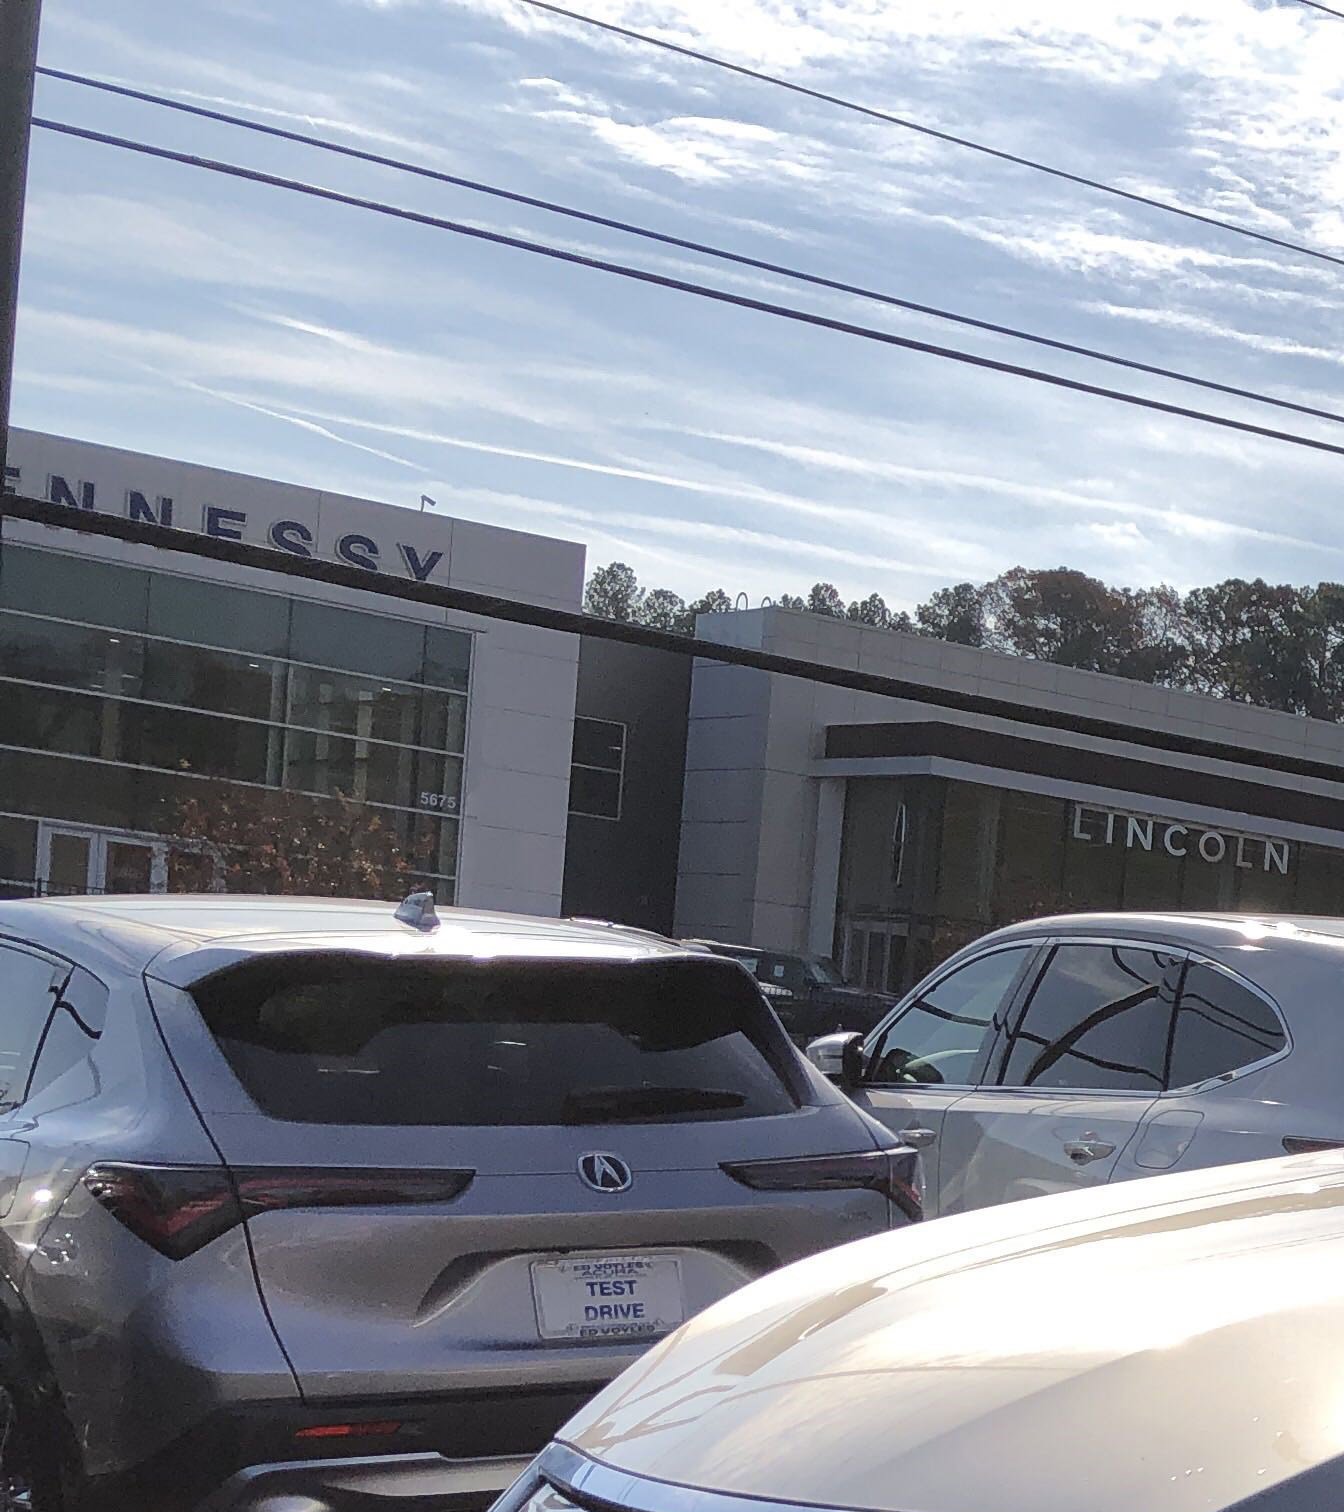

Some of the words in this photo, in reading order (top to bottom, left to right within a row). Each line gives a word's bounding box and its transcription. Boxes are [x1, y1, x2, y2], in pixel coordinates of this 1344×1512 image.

[420, 791, 457, 809] 5675
[1073, 803, 1290, 875] LINCOLN
[585, 1279, 638, 1297] TEST
[584, 1302, 646, 1322] DRIVE
